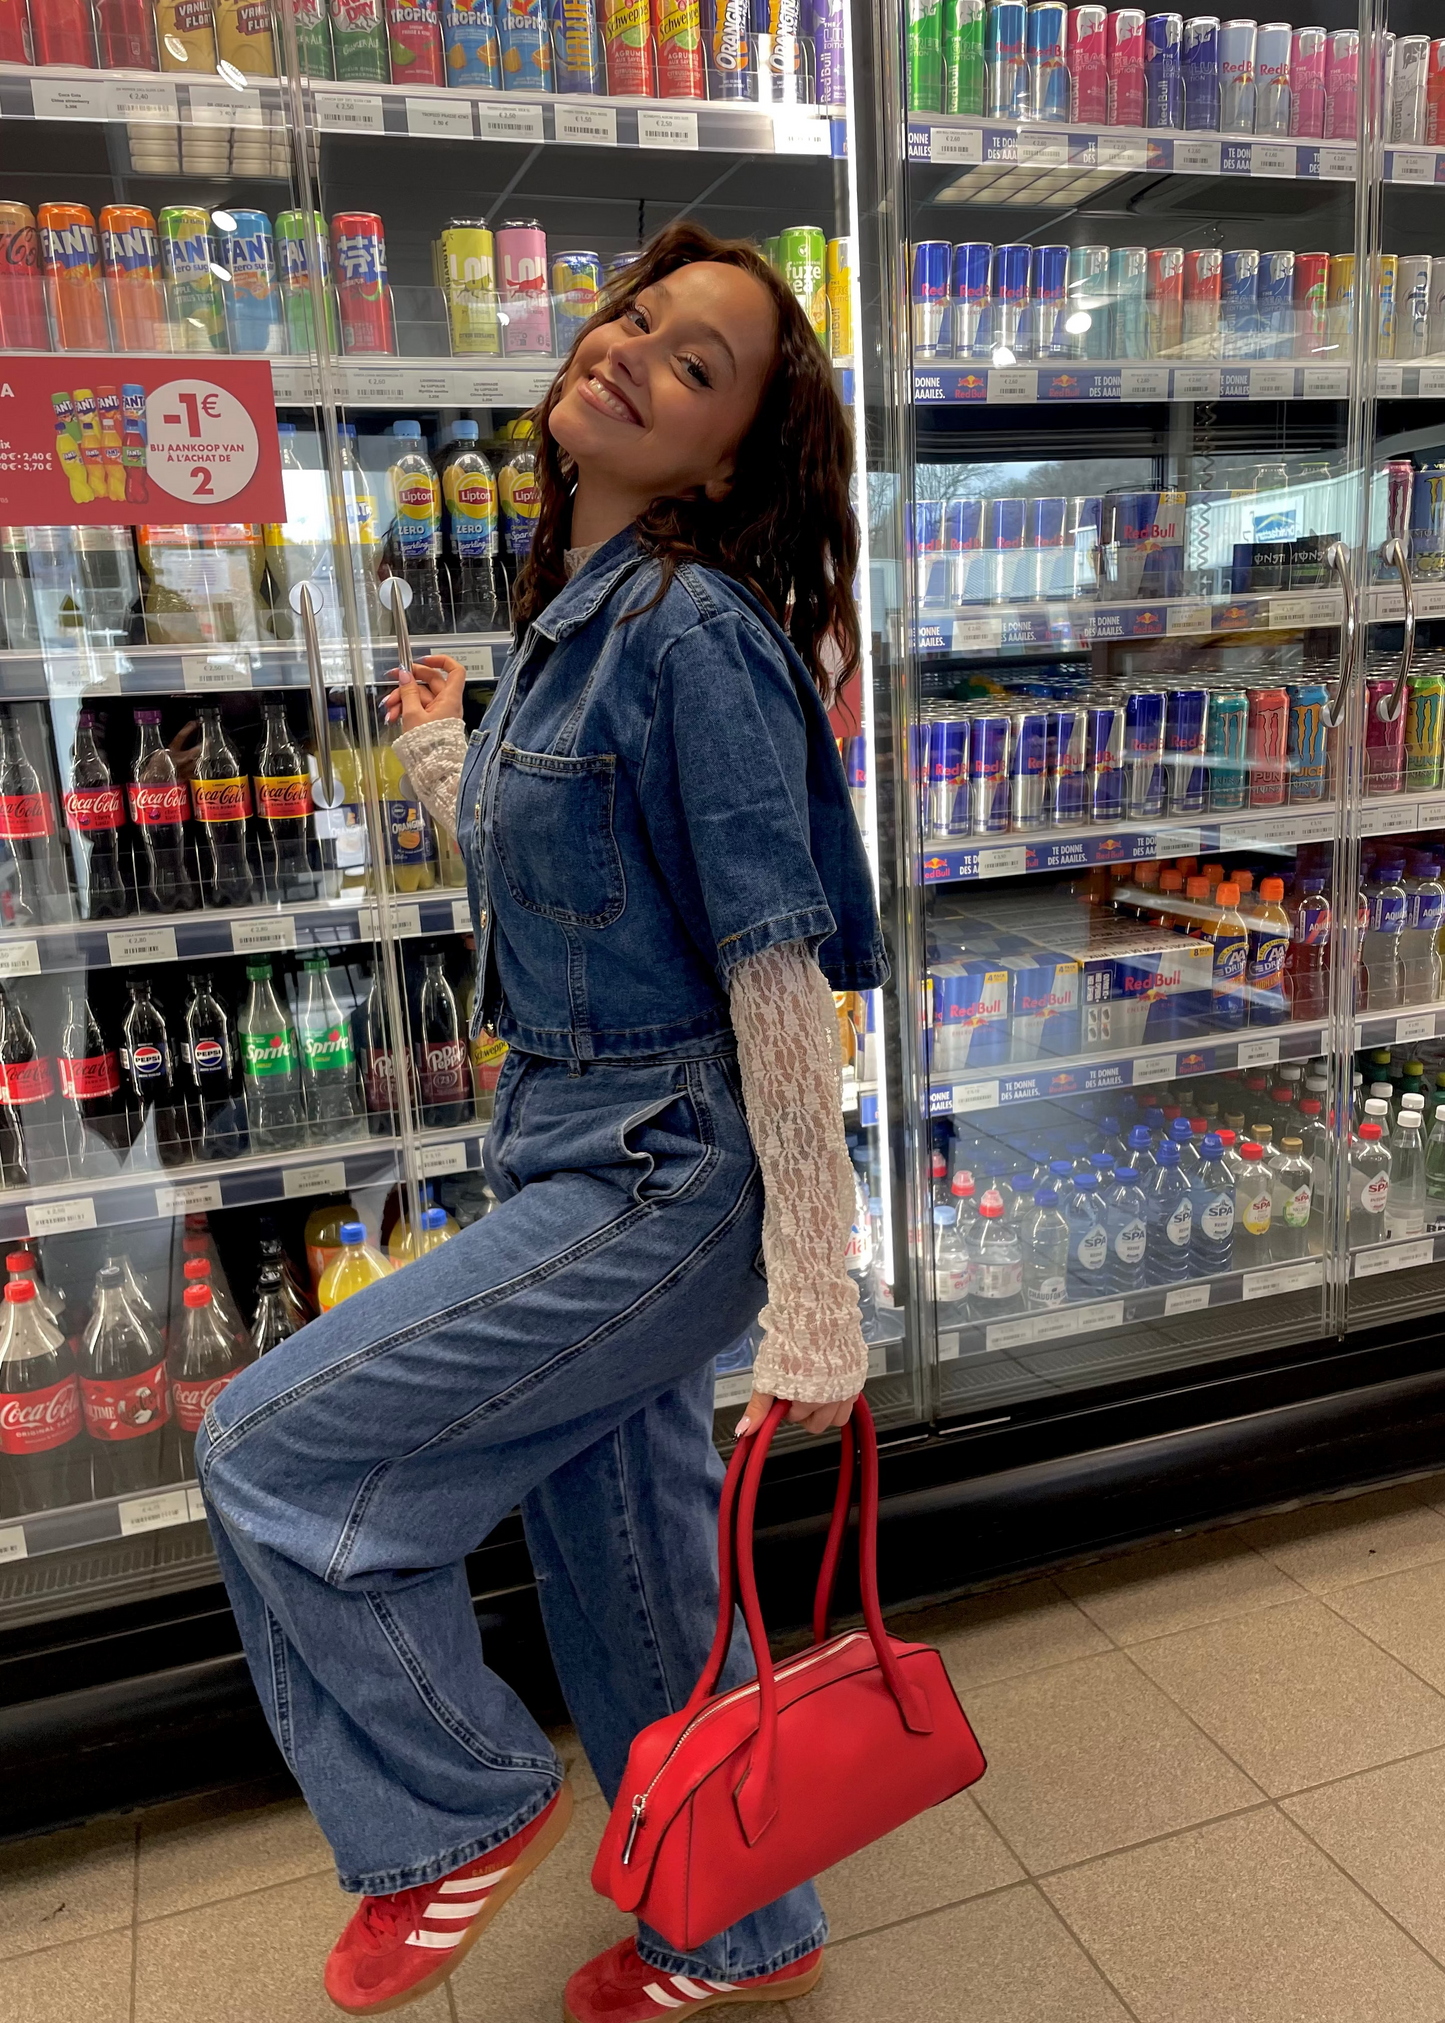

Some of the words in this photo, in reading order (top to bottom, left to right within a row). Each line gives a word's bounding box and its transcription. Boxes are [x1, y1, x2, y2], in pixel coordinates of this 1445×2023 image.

[390, 7, 437, 25] TROPICO
[446, 11, 493, 28] TROPICO
[502, 15, 548, 32] TROPICO
[1222, 61, 1245, 74] Red
[1260, 63, 1283, 76] Red
[1157, 80, 1168, 102] Bull
[1157, 102, 1168, 126] Red
[1427, 103, 1438, 123] Bull
[908, 133, 929, 142] ONNE
[993, 137, 1001, 146] TE
[1088, 142, 1096, 152] TE
[1228, 148, 1235, 157] TE
[987, 149, 1001, 159] DES
[1083, 153, 1096, 164] DES
[1223, 159, 1236, 170] DES
[233, 263, 253, 272] zero
[785, 261, 822, 280] fuze
[921, 283, 945, 297] Red
[960, 284, 983, 298] Red
[1000, 285, 1023, 299] Red
[1036, 286, 1060, 299] Red
[914, 377, 941, 388] DONNE
[1094, 376, 1102, 386] TE
[1102, 376, 1121, 387] DONN
[1225, 375, 1248, 386] DONNE
[0, 383, 15, 397] A
[914, 388, 946, 400] AAAILES.
[955, 388, 970, 399] Red
[971, 388, 987, 399] Bull
[1049, 388, 1063, 398] Red
[1089, 387, 1102, 398] DES
[150, 443, 165, 452] BIJ
[167, 443, 221, 453] AANKOOP
[222, 444, 245, 453] VAN
[23, 453, 44, 461] 2,40
[45, 453, 53, 461] €
[166, 450, 175, 462] À
[176, 453, 216, 463] L'ACHAT
[218, 454, 232, 462] DE
[23, 463, 44, 472] 3,70
[45, 463, 53, 471] €
[189, 466, 214, 495] 2
[402, 491, 433, 503] Lipton
[461, 491, 491, 504] Lipton
[397, 525, 425, 535] ZERO
[456, 524, 483, 534] ZERO
[1124, 524, 1151, 540] Red
[1151, 523, 1176, 538] Bull
[951, 538, 973, 550] Red
[996, 536, 1020, 549] Red
[1034, 535, 1057, 547] Red
[1008, 621, 1032, 632] DONNE
[1088, 617, 1096, 626] TE
[1097, 616, 1121, 626] DONNE
[1084, 627, 1096, 637] DES
[1096, 626, 1125, 637] AAAILES.
[1133, 625, 1147, 634] Red
[1148, 624, 1162, 634] Bull
[1008, 631, 1037, 642] AAAILES.
[1132, 738, 1156, 751] Red
[1171, 735, 1196, 748] Red
[935, 763, 959, 776] Red
[975, 760, 1001, 773] Red
[195, 783, 246, 805] Coca-Cola
[259, 780, 308, 802] Coca-Cola
[67, 790, 120, 814] Coca-Cola
[136, 786, 188, 809] Coca-Cola
[1137, 837, 1145, 846] TE
[1052, 846, 1061, 856] TE
[1061, 844, 1083, 855] DONNE
[1096, 850, 1110, 860] Red
[1110, 849, 1125, 859] Bull
[1133, 846, 1144, 856] DES
[964, 855, 972, 864] TE
[1047, 855, 1060, 866] DES
[1060, 853, 1088, 865] AAAILES.
[936, 868, 951, 878] Bull
[959, 865, 971, 875] DES
[1193, 949, 1199, 957] 8
[1229, 949, 1246, 966] AA
[1268, 946, 1286, 962] AA
[1225, 961, 1246, 975] DRIN
[988, 974, 993, 982] 4
[1124, 975, 1153, 992] Red
[1153, 970, 1182, 987] Bull
[1022, 994, 1047, 1009] Red
[1048, 991, 1071, 1006] Bull
[951, 1002, 976, 1018] Red
[977, 1000, 1001, 1015] Bull
[305, 1035, 349, 1056] Sprite
[196, 1049, 221, 1057] PEPSI
[246, 1042, 291, 1063] Sprite
[135, 1055, 161, 1063] PEPSI
[1090, 1070, 1097, 1079] TE
[1097, 1067, 1120, 1078] DONNE
[1179, 1066, 1192, 1074] Red
[1192, 1063, 1206, 1072] Bull
[1005, 1082, 1012, 1090] TE
[1013, 1079, 1036, 1090] DONNE
[1085, 1079, 1097, 1089] DES
[1097, 1076, 1124, 1088] AAAILES.
[929, 1091, 950, 1101] ONNE
[1001, 1092, 1012, 1101] DES
[1013, 1088, 1041, 1100] AAAILES.
[1368, 1181, 1388, 1193] SPA
[1294, 1193, 1310, 1203] SPA
[1209, 1206, 1233, 1217] SPA
[1252, 1201, 1271, 1211] SPA
[1084, 1236, 1107, 1248] SPA
[1121, 1230, 1145, 1242] SPA
[0, 1384, 78, 1430] Coca-Cola
